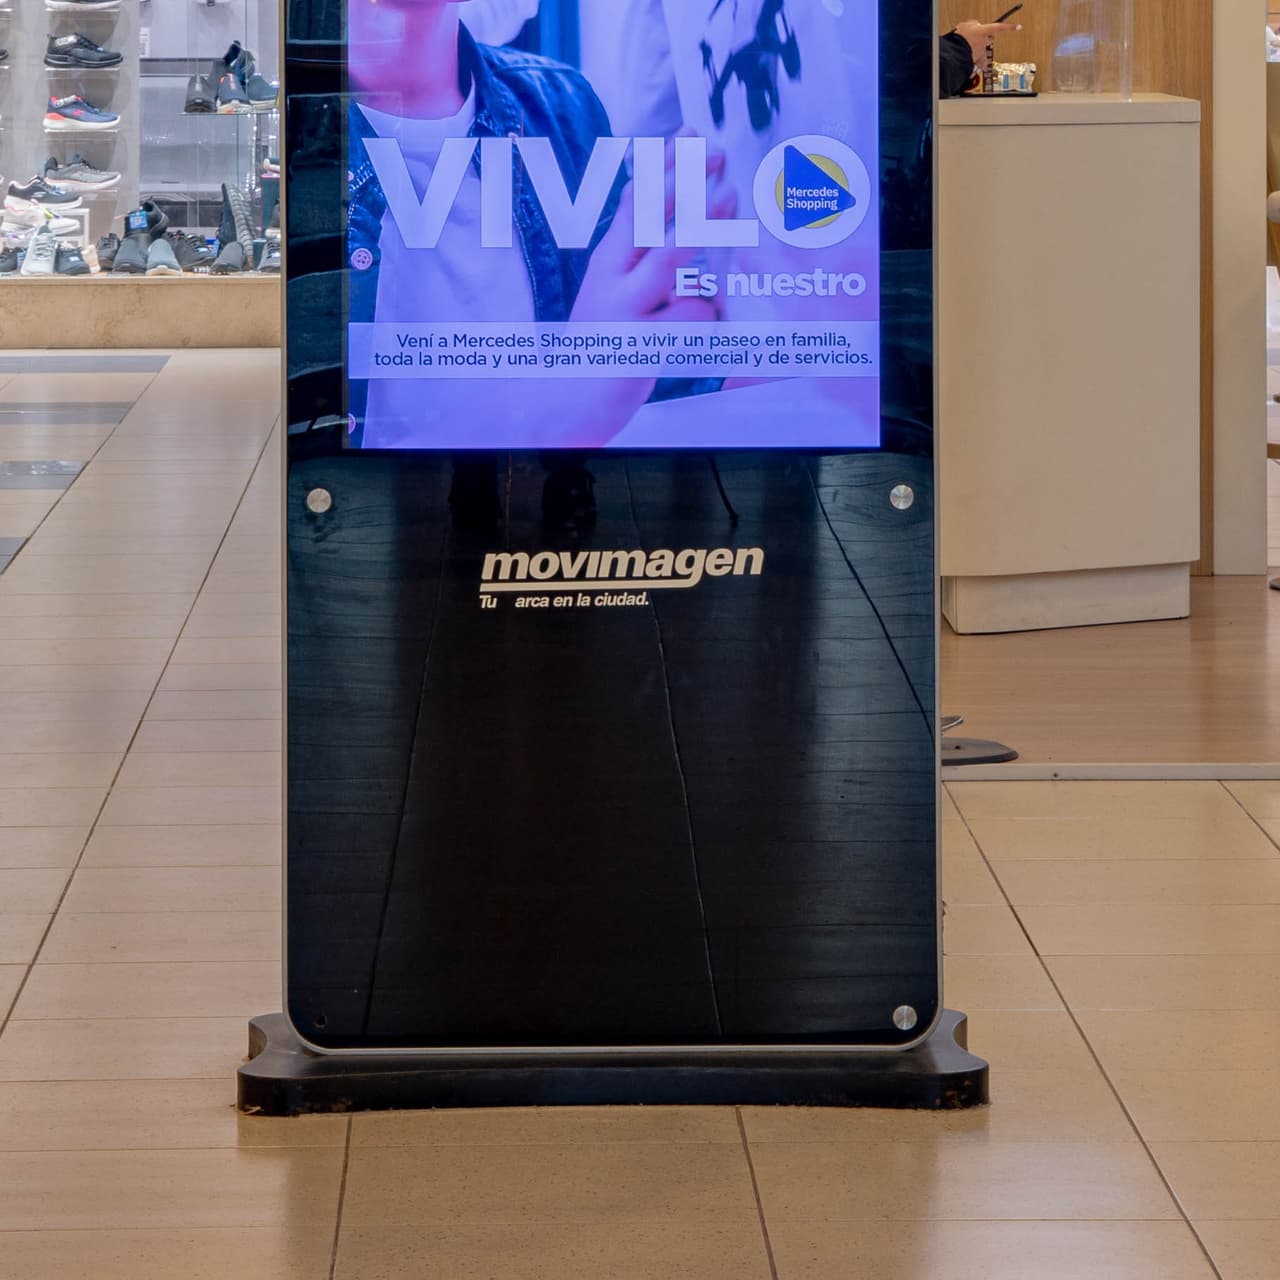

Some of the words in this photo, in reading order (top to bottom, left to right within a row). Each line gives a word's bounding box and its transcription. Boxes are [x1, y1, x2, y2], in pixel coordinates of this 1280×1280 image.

[786, 186, 839, 197] Mercedes
[786, 198, 838, 210] Shopping
[675, 267, 719, 297] Es
[726, 268, 867, 297] nuestro
[396, 333, 433, 348] Vení
[438, 336, 448, 348] a
[453, 333, 535, 348] Mercedes
[540, 333, 623, 350] Shopping
[627, 336, 637, 348] a
[642, 333, 679, 348] vivir
[683, 335, 704, 347] un
[709, 335, 761, 350] paseo
[765, 335, 786, 347] en
[791, 332, 851, 348] familia,
[374, 351, 413, 366] toda
[419, 351, 433, 366] la
[438, 351, 487, 366] moda
[492, 353, 503, 368] y
[507, 353, 538, 366] una
[543, 353, 581, 368] gran
[586, 351, 661, 366] variedad
[665, 350, 749, 365] comercial
[753, 352, 763, 367] y
[768, 350, 790, 365] de
[794, 350, 873, 365] servicios.
[480, 547, 765, 582] movimagen
[479, 594, 498, 609] Tu
[553, 594, 572, 607] en
[576, 593, 592, 607] la
[594, 592, 650, 607] ciudad.
